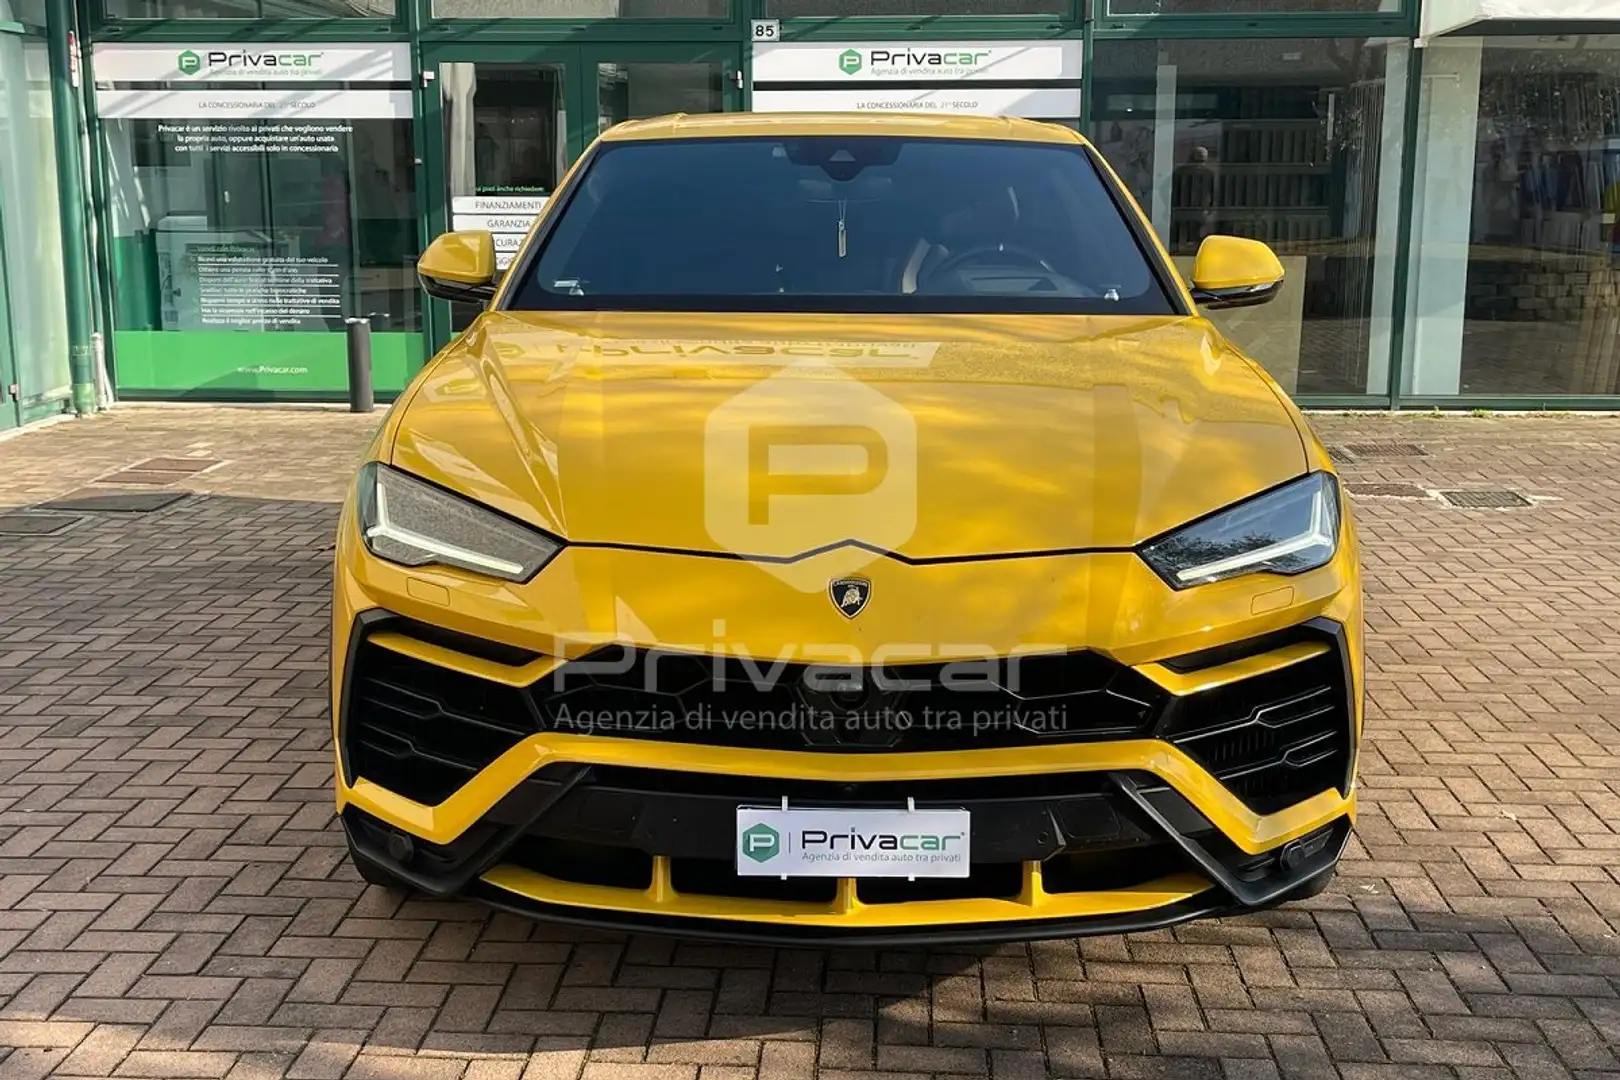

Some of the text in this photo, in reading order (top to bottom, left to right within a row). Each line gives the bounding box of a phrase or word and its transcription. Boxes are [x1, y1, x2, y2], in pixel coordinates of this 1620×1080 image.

[755, 25, 775, 37] 85
[207, 49, 322, 67] Privacar
[871, 47, 990, 66] Privacar
[202, 124, 228, 132] servizio
[280, 124, 293, 132] che
[294, 124, 325, 134] vogliono
[325, 124, 354, 132] vendere
[289, 144, 339, 152] concessionaria
[475, 201, 541, 209] FINANZIAMENTI
[486, 220, 530, 228] GARANZIA
[749, 833, 776, 852] P
[802, 826, 962, 851] Privacar
[801, 852, 961, 864] Agenzia di vendita auto tra privati
